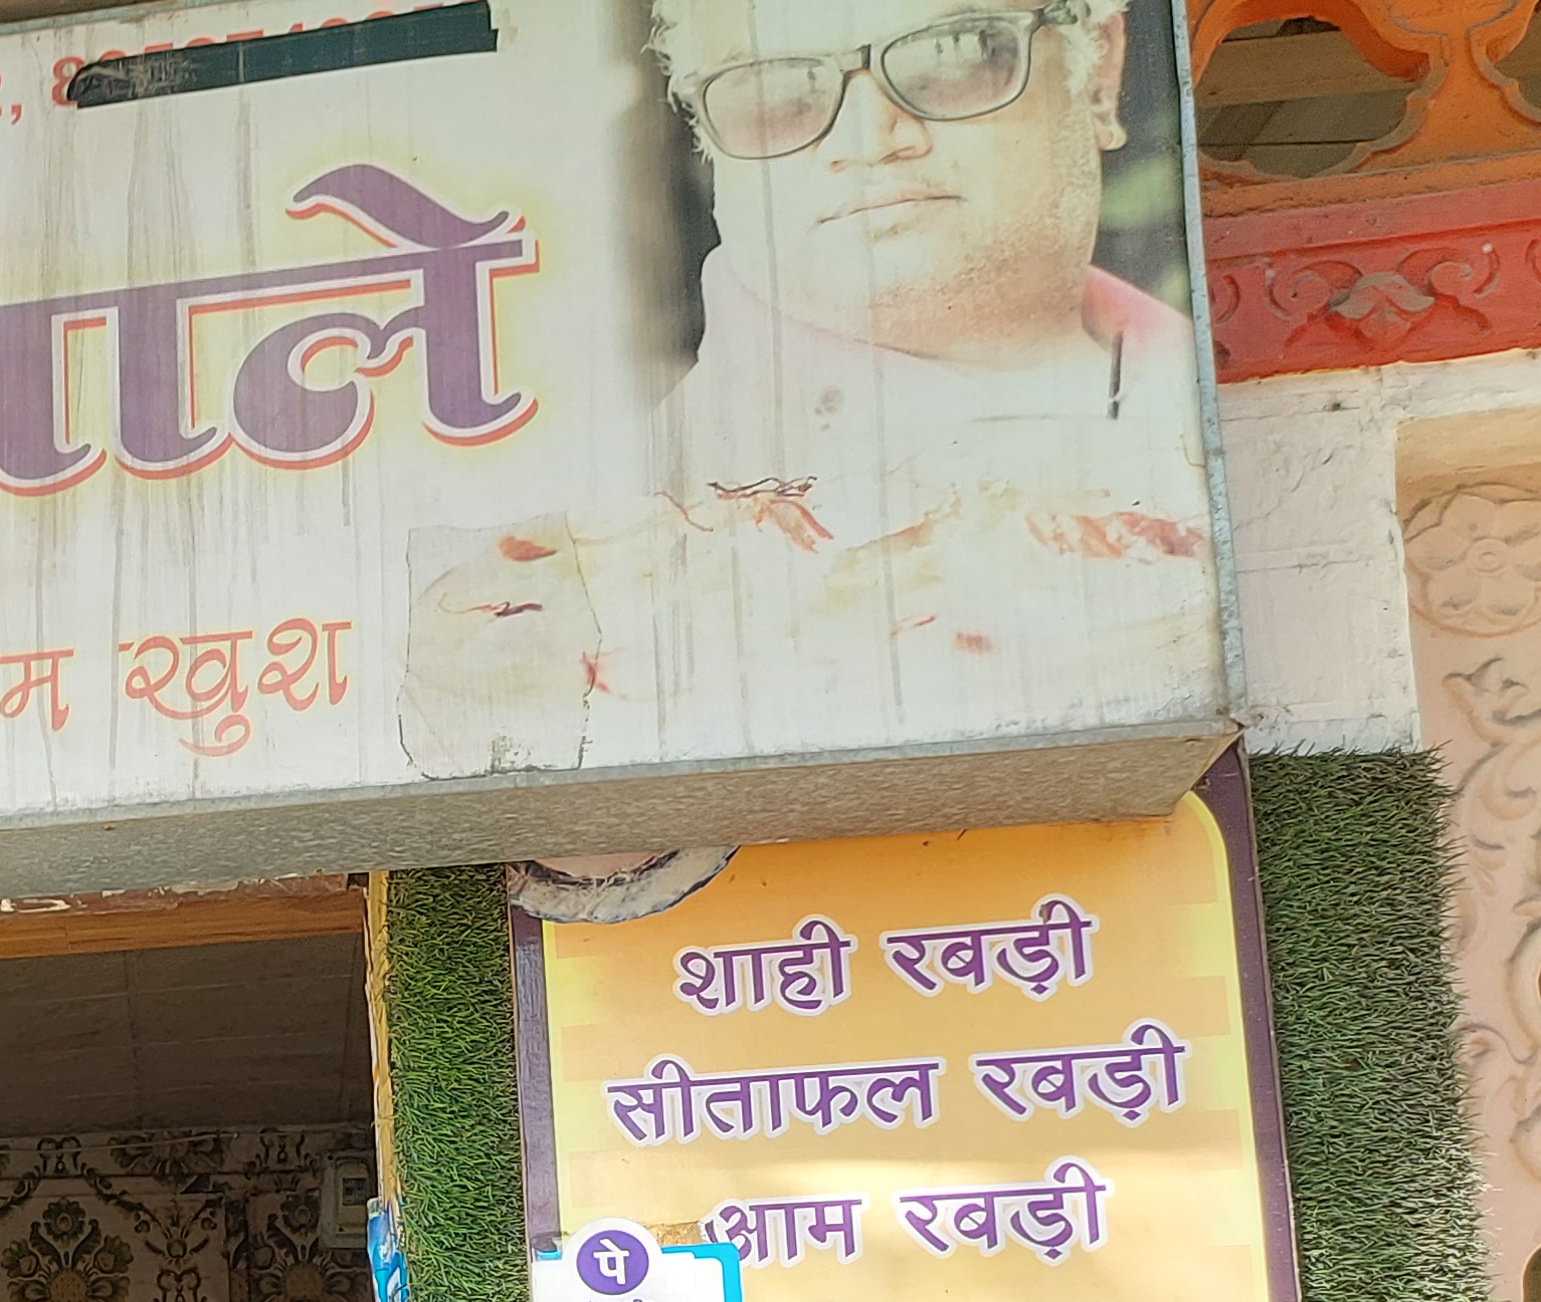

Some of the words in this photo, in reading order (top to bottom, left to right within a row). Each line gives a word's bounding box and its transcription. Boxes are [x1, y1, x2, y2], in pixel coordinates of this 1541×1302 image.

[117, 618, 354, 754] खुश
[678, 919, 852, 1012] शाही
[887, 899, 1093, 994] रबड़ी
[606, 1057, 938, 1142] सीताफल
[975, 1024, 1186, 1123] रबड़ी
[706, 1199, 862, 1263] आम
[898, 1161, 1108, 1259] रबड़ी
